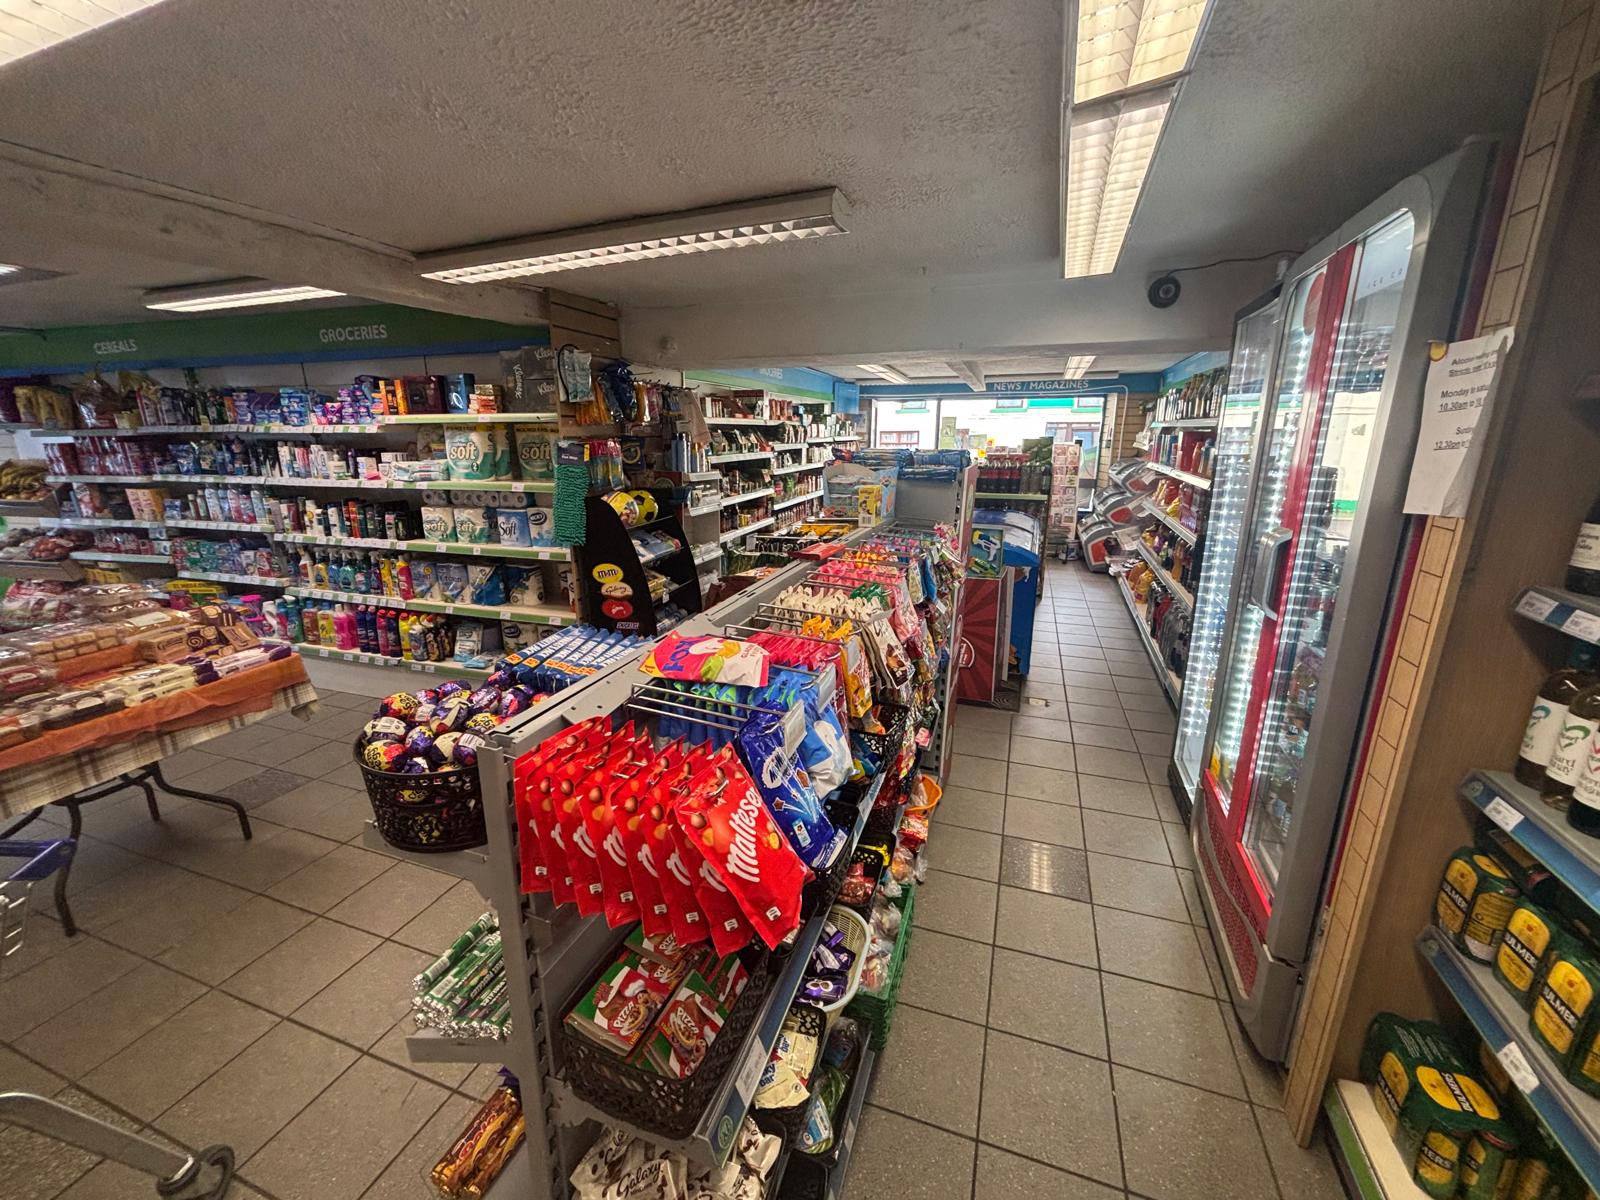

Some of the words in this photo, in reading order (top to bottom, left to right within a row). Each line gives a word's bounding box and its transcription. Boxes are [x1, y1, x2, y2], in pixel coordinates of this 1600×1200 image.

[319, 324, 388, 343] GROCERIES
[94, 339, 138, 354] CEREALS
[993, 382, 1021, 391] NEWS
[1029, 380, 1089, 390] MAGAZINES
[1441, 388, 1469, 399] Monday
[450, 441, 477, 460] soft
[521, 442, 551, 460] soft
[499, 521, 517, 537] Soft
[659, 934, 675, 951] PIZZ
[613, 1001, 634, 1029] PIZZA
[676, 1006, 700, 1034] PIZZA
[616, 1161, 662, 1198] Galaxy
